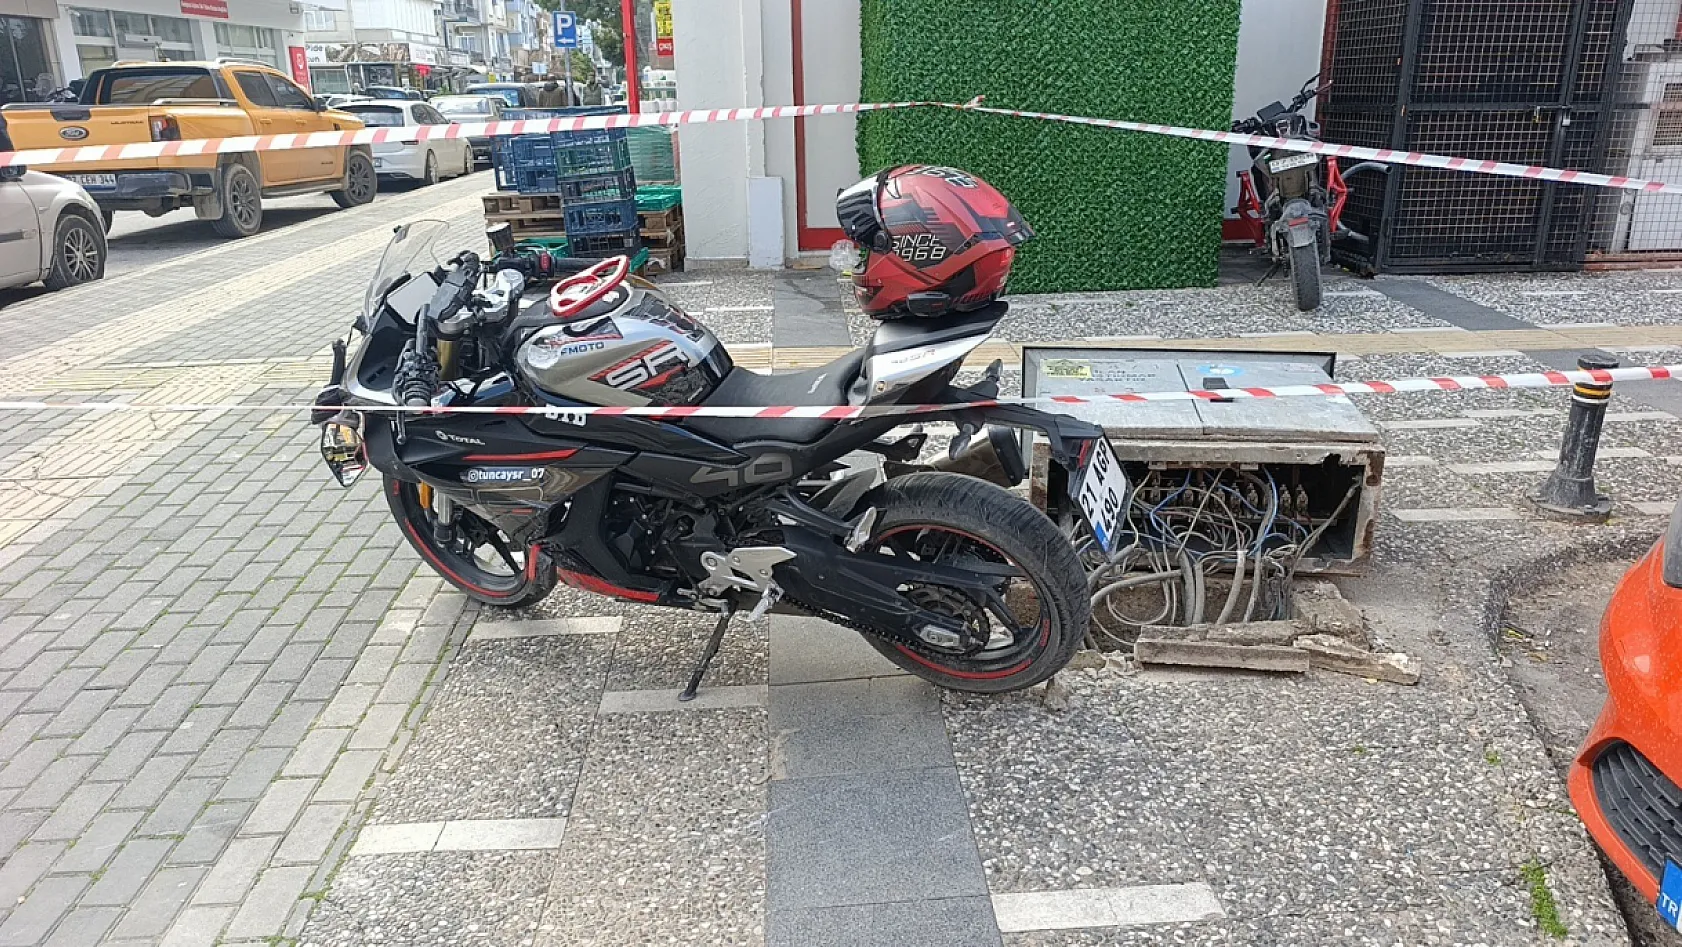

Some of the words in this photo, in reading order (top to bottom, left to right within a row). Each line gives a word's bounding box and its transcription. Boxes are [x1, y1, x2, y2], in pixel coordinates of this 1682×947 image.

[556, 13, 573, 36] P
[560, 341, 605, 356] FMOTO
[448, 434, 486, 446] TOTAL
[1082, 482, 1097, 519] 21
[1101, 486, 1119, 533] 490
[1661, 893, 1679, 917] TR
